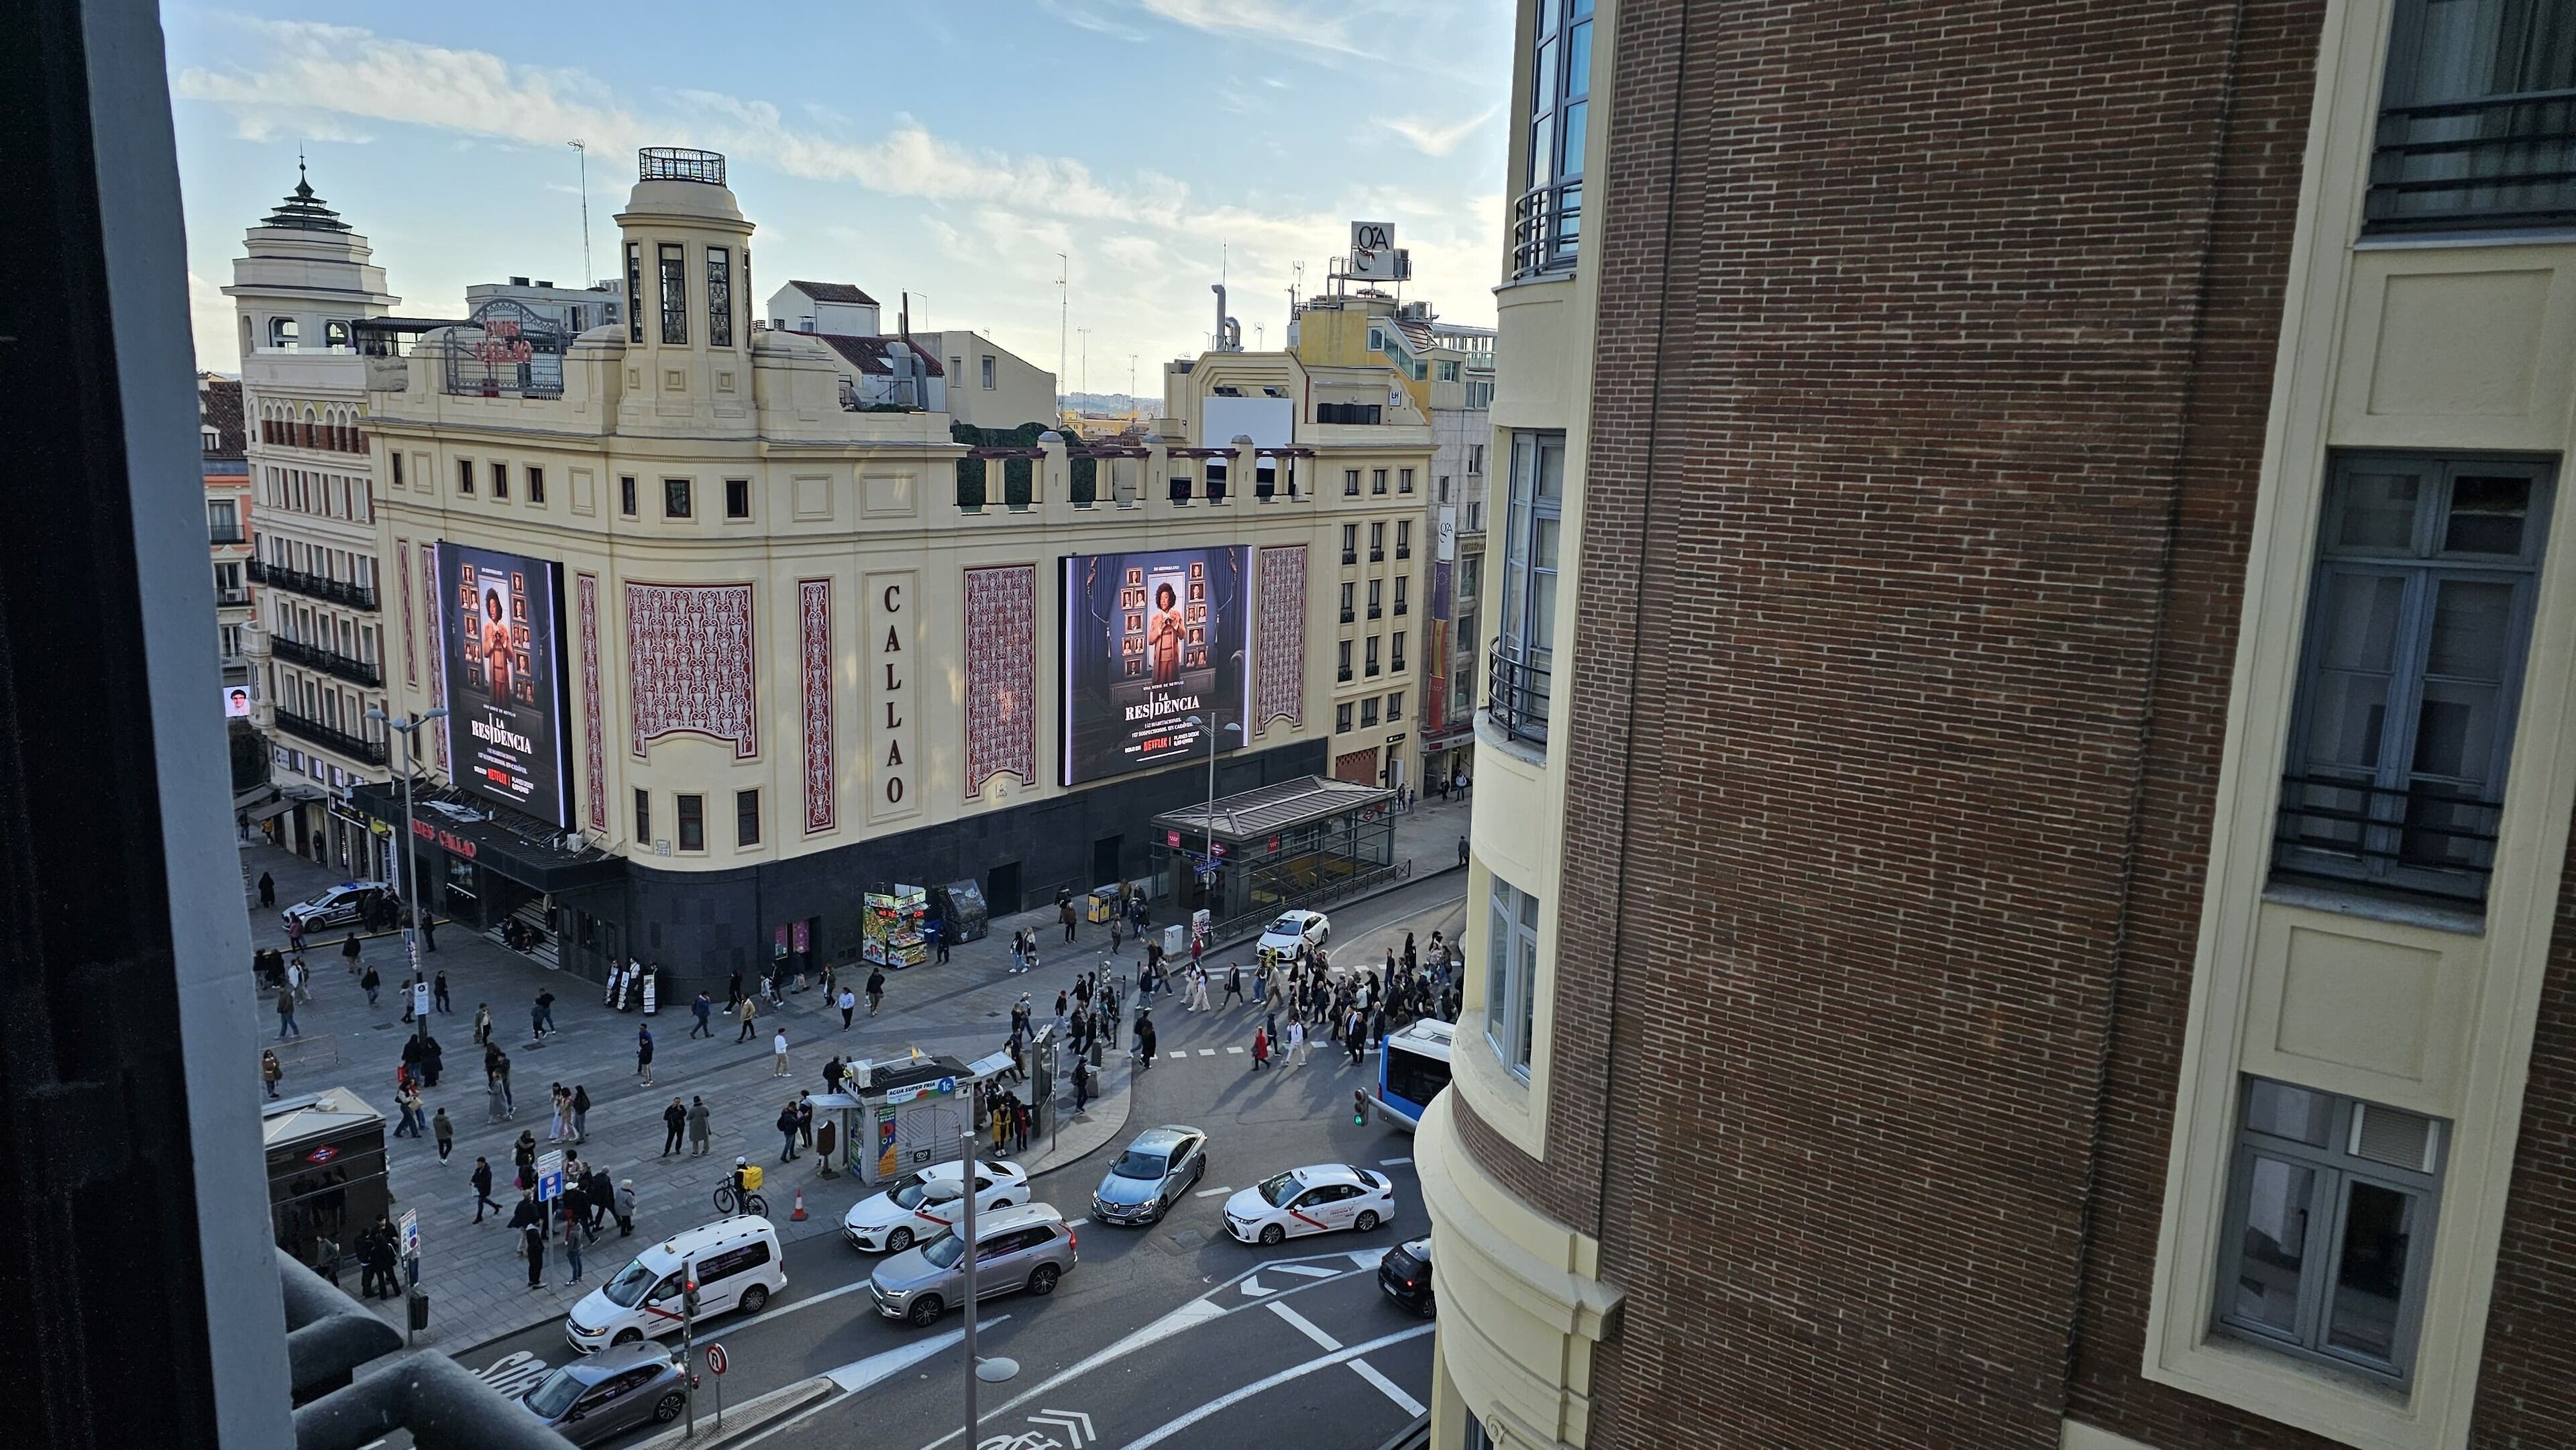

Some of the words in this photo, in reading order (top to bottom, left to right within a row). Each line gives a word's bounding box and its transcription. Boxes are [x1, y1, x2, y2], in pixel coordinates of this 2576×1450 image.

[475, 340, 532, 362] CALLAO
[884, 585, 903, 803] CALLAO
[1159, 692, 1169, 702] LA
[1125, 692, 1199, 721] RESIDENCIA
[472, 713, 532, 754] RESIDENCIA
[496, 718, 504, 729] LA
[1144, 737, 1167, 752] NETFLIX
[439, 831, 476, 858] CALLAO
[905, 1084, 922, 1092] SUPER
